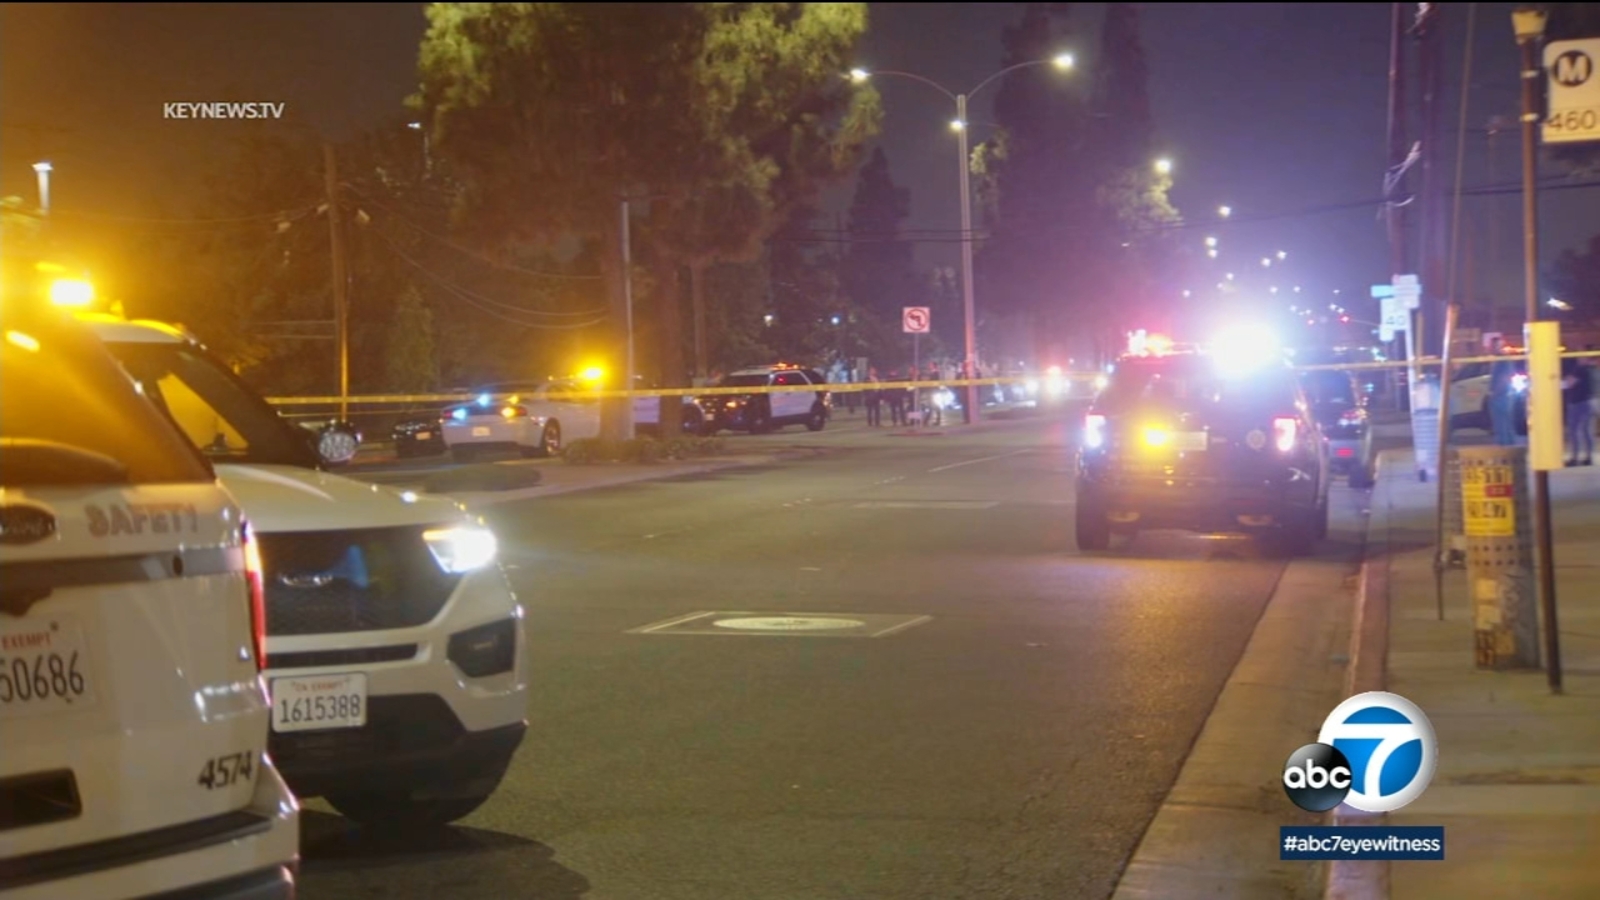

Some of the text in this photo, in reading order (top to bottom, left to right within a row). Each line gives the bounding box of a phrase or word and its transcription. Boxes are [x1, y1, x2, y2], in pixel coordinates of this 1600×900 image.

[1556, 53, 1588, 84] M
[1548, 109, 1597, 131] 460
[280, 694, 361, 723] 1615388
[198, 750, 252, 790] 4574
